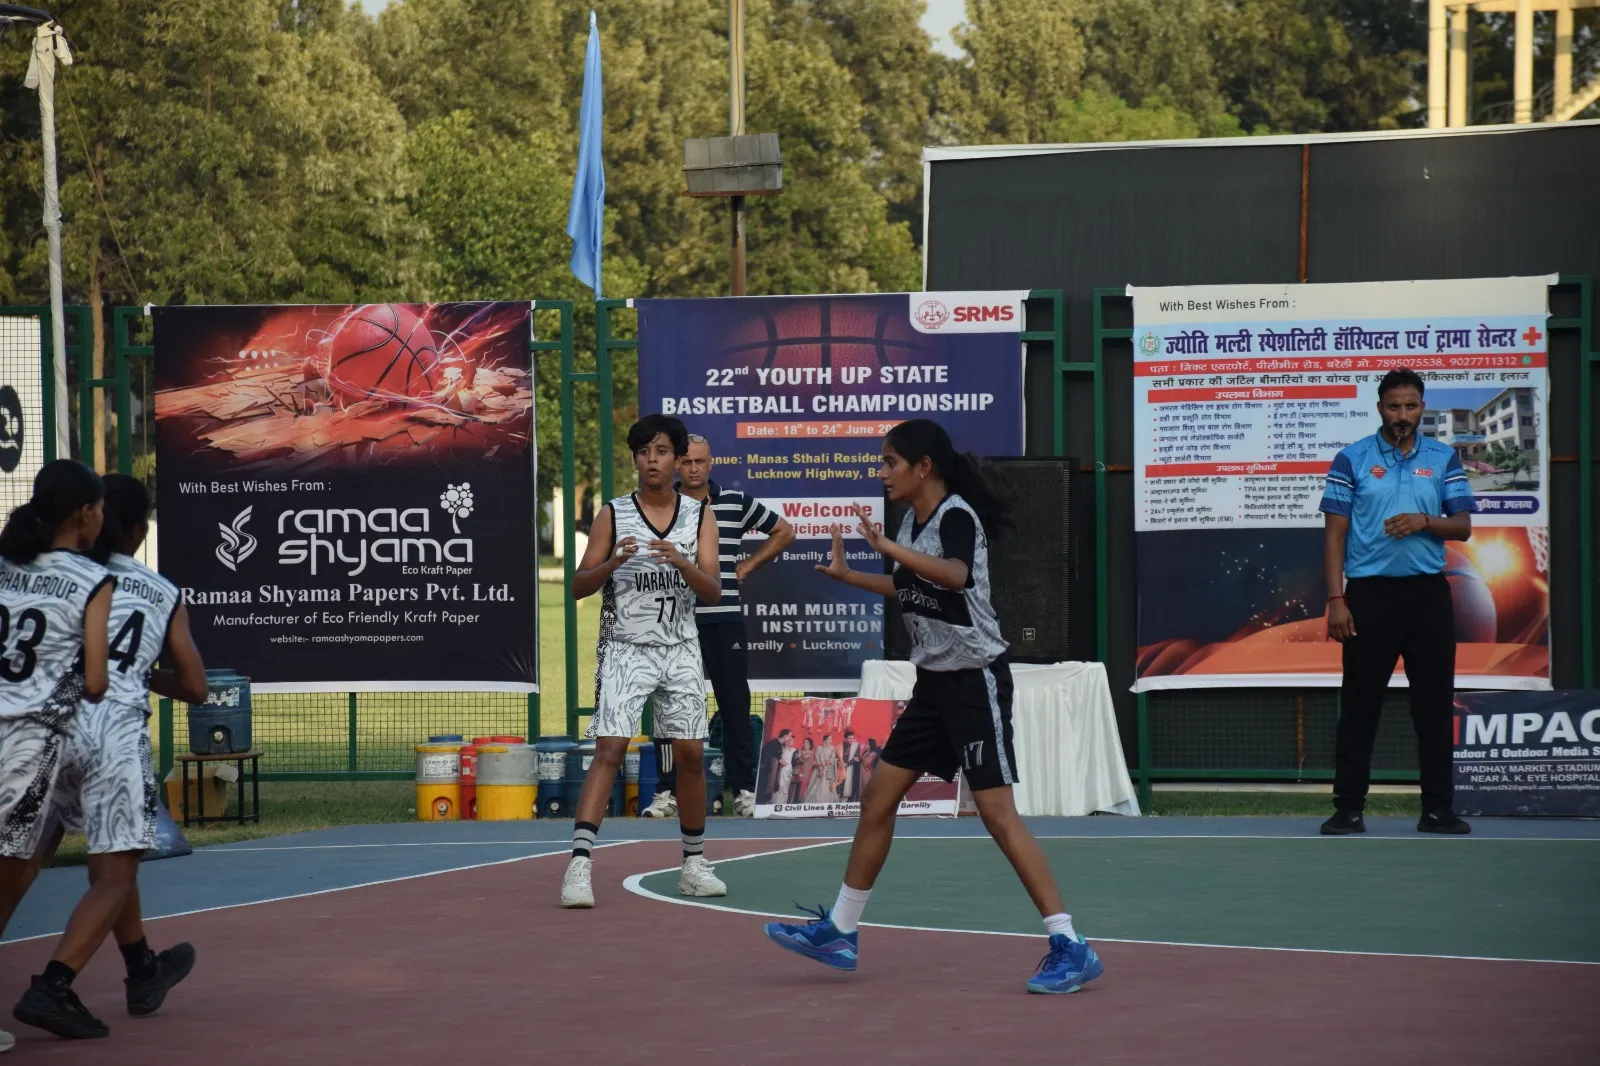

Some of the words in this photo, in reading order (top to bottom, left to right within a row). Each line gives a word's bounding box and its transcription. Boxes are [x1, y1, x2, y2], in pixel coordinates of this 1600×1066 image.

[1160, 301, 1184, 312] With
[1188, 300, 1212, 310] Best
[1216, 299, 1256, 310] Wishes
[1260, 298, 1289, 308] From
[953, 305, 1014, 322] SRMS
[1164, 330, 1209, 354] ज्योति
[1214, 329, 1252, 352] मल्टी
[1258, 328, 1328, 352] स्पेशलिटी
[1333, 326, 1400, 350] हॉस्पिटल
[1405, 324, 1431, 349] एवं
[1435, 330, 1471, 352] ट्रामा
[1477, 324, 1517, 348] सेन्टर
[1180, 363, 1207, 372] निकट
[1256, 360, 1298, 370] पीलीभीत
[1326, 359, 1352, 368] बरेली
[1450, 356, 1517, 366] 9027711312
[706, 366, 749, 387] 22nd
[756, 367, 832, 386] YOUTH
[841, 366, 872, 384] UP
[880, 365, 948, 384] STATE
[1152, 378, 1174, 388] सभी
[1178, 377, 1205, 387] प्रकार
[1208, 376, 1222, 386] की
[1226, 375, 1255, 386] जटिल
[1260, 372, 1303, 384] बीमारियों
[1308, 375, 1322, 384] का
[1326, 372, 1351, 383] योग्य
[1356, 372, 1370, 384] एवं
[1474, 371, 1494, 382] द्वारा
[1500, 372, 1530, 381] इलाज
[1216, 390, 1250, 399] उपलब्ध
[1252, 388, 1284, 398] विभाग
[662, 396, 804, 416] BASKETBALL
[812, 393, 994, 414] CHAMPIONSHIP
[747, 426, 778, 436] Date:
[806, 426, 818, 434] to
[846, 425, 874, 434] June
[878, 424, 894, 434] 20
[710, 456, 742, 464] enue:
[747, 454, 788, 464] Manas
[793, 452, 830, 464] Sthali
[747, 468, 800, 479] Lucknow
[806, 468, 863, 480] Highway,
[179, 482, 207, 494] With
[211, 481, 240, 494] Best
[242, 480, 288, 492] Wishes
[292, 480, 324, 492] From
[278, 508, 430, 534] ramaa
[279, 533, 472, 576] shyama
[782, 552, 824, 563] Bareilly
[402, 566, 418, 576] Eco
[421, 566, 444, 576] Kraft
[446, 566, 472, 577] Paper
[32, 575, 78, 600] GROUP
[122, 576, 164, 607] GROUP
[180, 585, 252, 606] Ramaa
[259, 585, 341, 608] Shyama
[348, 584, 418, 606] Papers
[426, 583, 465, 602] Pvt.
[472, 583, 515, 602] Ltd.
[655, 596, 676, 624] 77
[756, 604, 798, 616] RAM
[805, 604, 866, 616] MURTI
[874, 603, 884, 616] S
[213, 613, 300, 626] Manufacturer
[304, 612, 318, 624] of
[322, 612, 344, 624] Eco
[348, 611, 400, 626] Friendly
[404, 611, 437, 624] Kraft
[442, 611, 480, 626] Paper
[312, 634, 424, 644] ramaashyamapapers.com
[748, 640, 784, 652] areilly
[803, 640, 861, 650] Lucknow
[1454, 749, 1486, 758] ndoor
[1490, 748, 1498, 758] &
[1502, 748, 1548, 758] Outdoor
[1552, 746, 1589, 756] Media
[1592, 746, 1600, 756] S
[1459, 765, 1508, 774] UPADHAY
